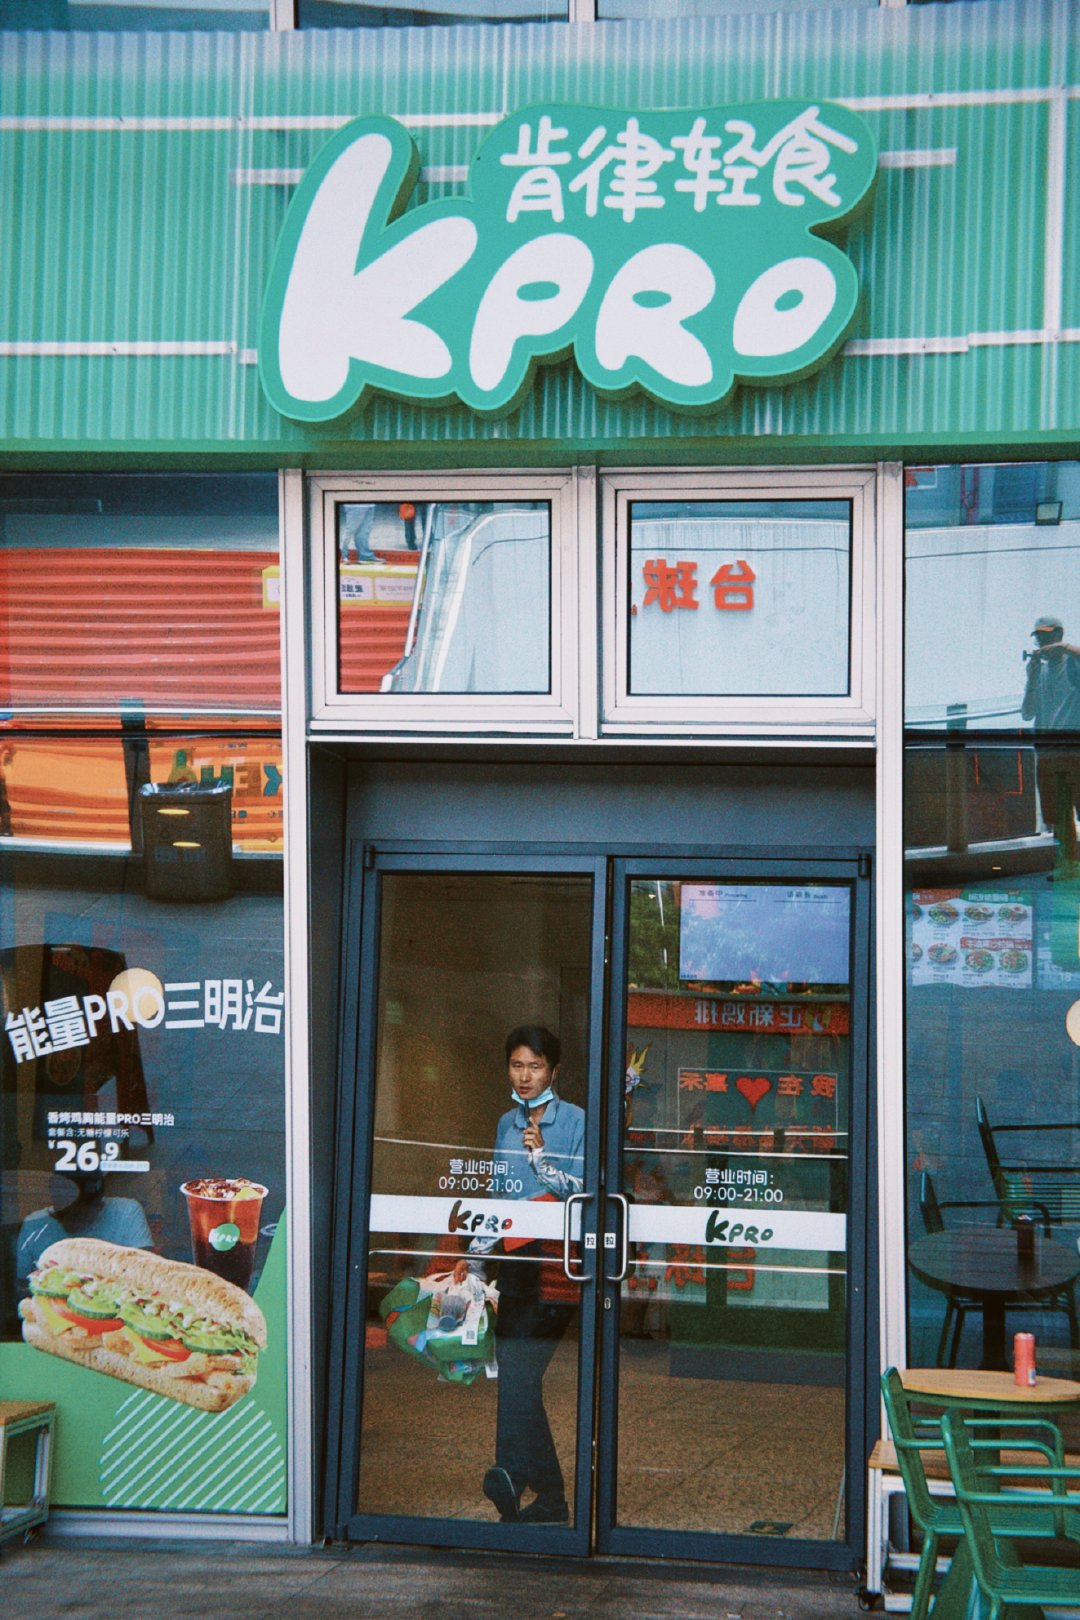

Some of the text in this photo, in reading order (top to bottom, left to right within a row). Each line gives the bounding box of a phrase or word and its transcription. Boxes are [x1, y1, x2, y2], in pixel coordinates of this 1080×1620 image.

[500, 106, 858, 223] 肯律轻食
[279, 132, 837, 403] KPRO
[4, 978, 284, 1063] 能量PRO三明治
[438, 1175, 523, 1193] 09:00-21:00
[694, 1185, 783, 1203] 09:00-21:00
[447, 1199, 513, 1233] KPRO
[705, 1209, 774, 1244] KPRO
[605, 1235, 616, 1247] 拉
